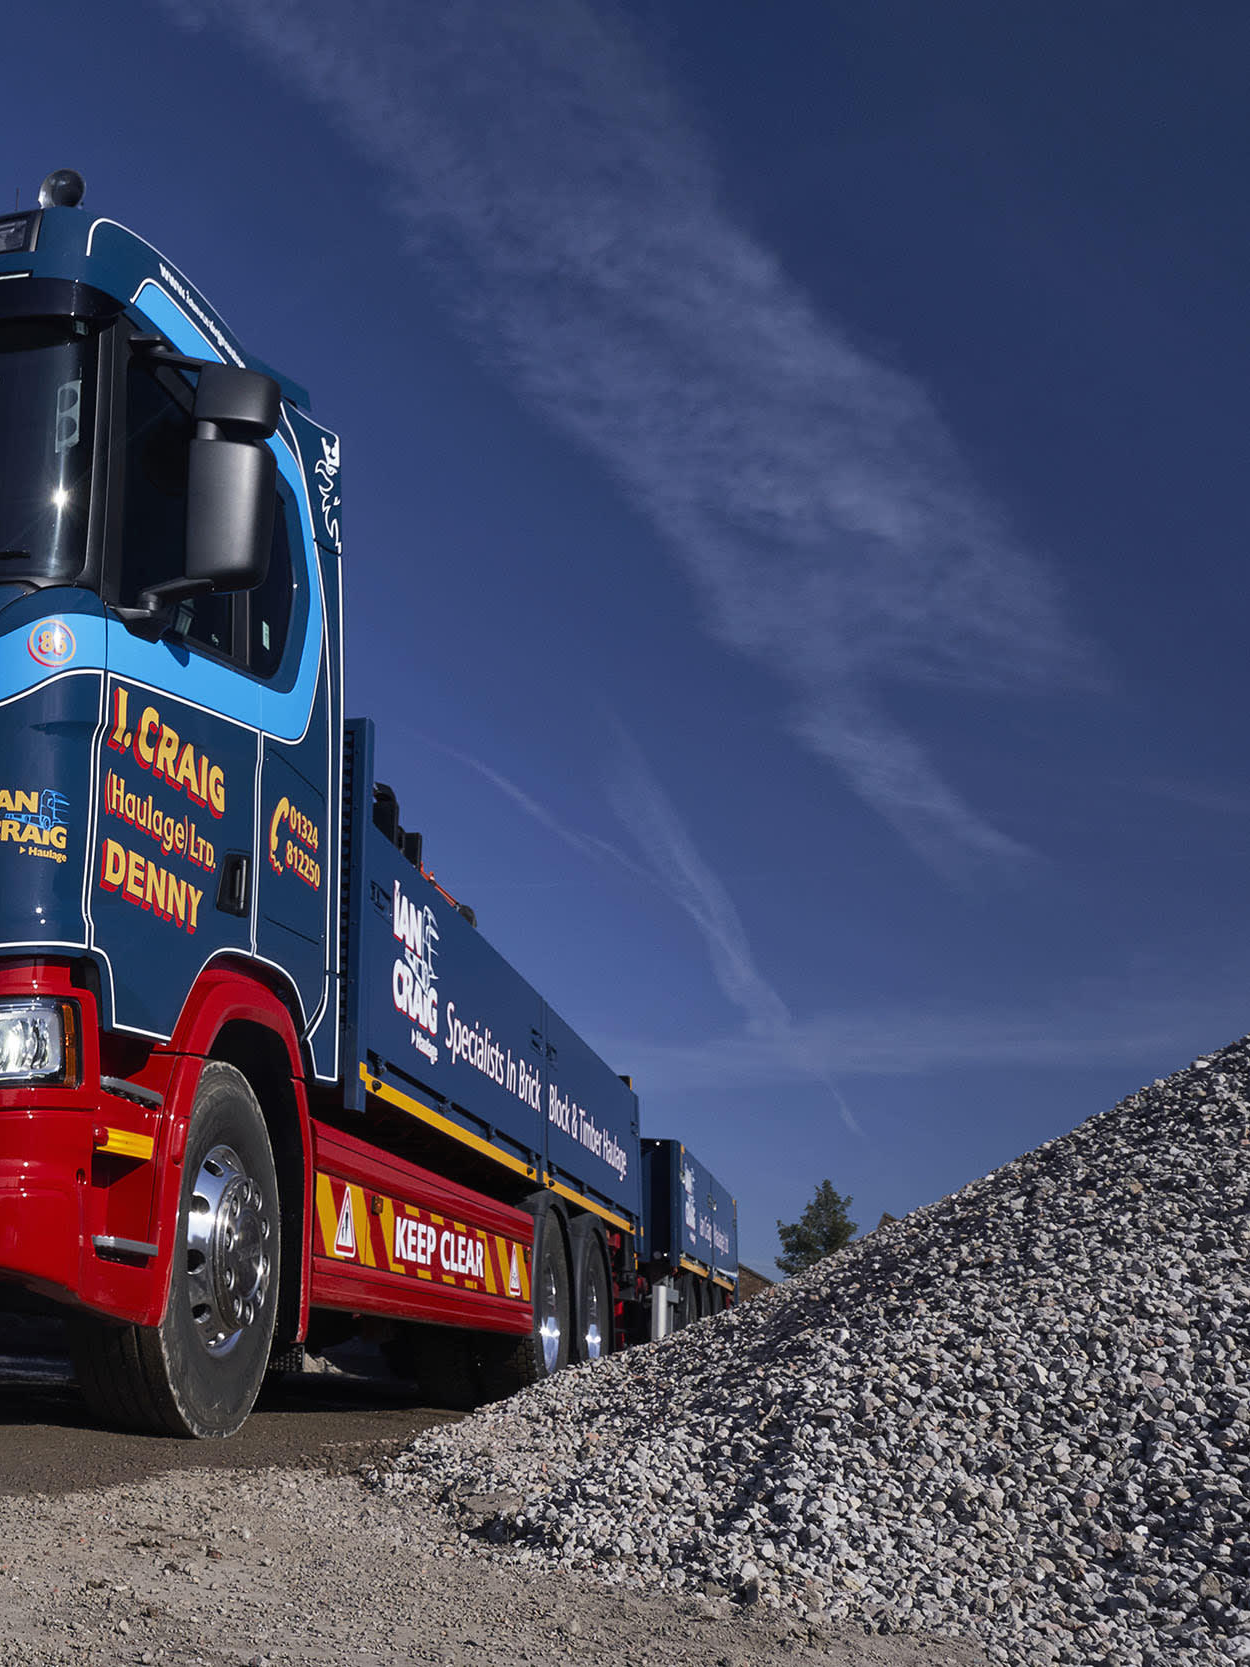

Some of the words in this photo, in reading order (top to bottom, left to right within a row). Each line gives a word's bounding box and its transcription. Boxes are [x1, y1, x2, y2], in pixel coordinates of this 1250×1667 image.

[108, 687, 132, 754] I.
[134, 706, 225, 819] CRAIG
[105, 768, 188, 857] (Haulage)
[289, 805, 319, 853] 01324
[28, 846, 67, 864] Haulage
[100, 837, 203, 934] DENNY
[285, 839, 321, 891] 812250
[393, 880, 422, 958] IAN
[392, 958, 439, 1036] CRAIG
[445, 1001, 505, 1086] Specialists
[506, 1049, 517, 1094] In
[518, 1059, 542, 1112] Brick
[549, 1083, 570, 1134] Block
[571, 1102, 578, 1140] &
[579, 1108, 602, 1157] Timber
[603, 1128, 627, 1182] Haulage
[395, 1216, 436, 1265] KEEP
[440, 1230, 484, 1278] CLEAR
